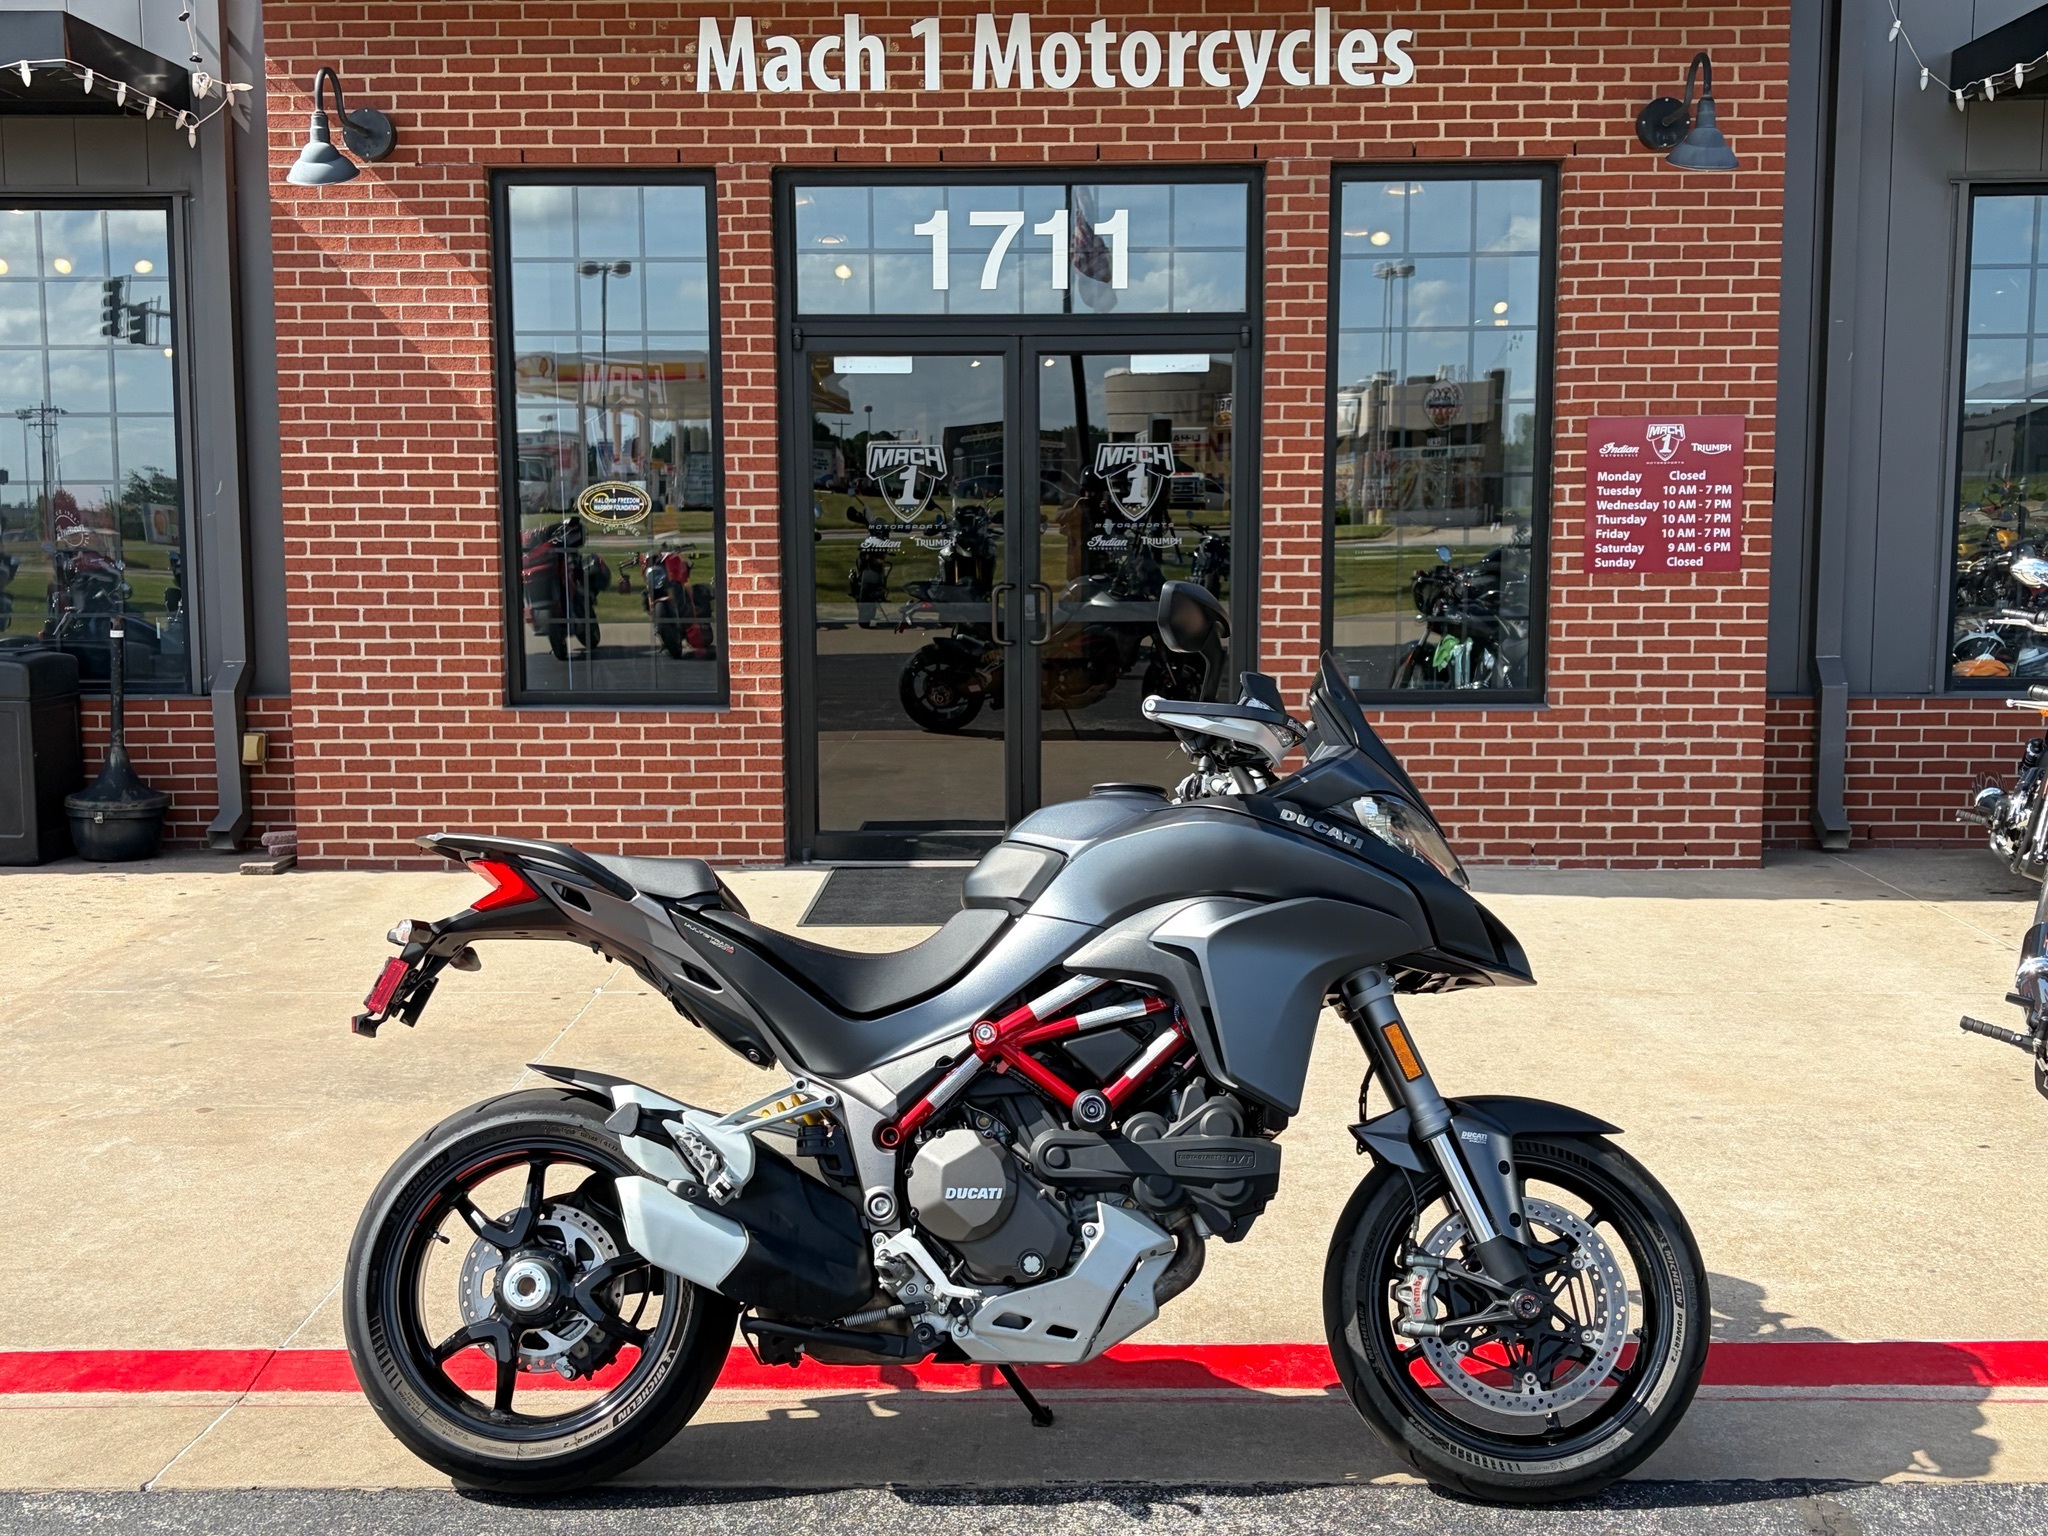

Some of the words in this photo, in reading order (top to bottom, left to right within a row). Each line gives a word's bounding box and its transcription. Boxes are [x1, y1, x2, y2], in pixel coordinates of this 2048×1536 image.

[696, 13, 887, 93] Mach
[910, 17, 941, 91] 1
[972, 7, 1415, 109] Motorcycles
[914, 209, 1129, 290] 1711
[1648, 426, 1684, 438] MACH
[1598, 442, 1640, 454] Indian
[1658, 433, 1672, 453] 1
[1690, 442, 1732, 453] TRIUMPH
[870, 448, 944, 474] MACH
[1098, 446, 1172, 472] MACH
[1597, 471, 1642, 483] Monday
[1669, 470, 1706, 480] Closed
[894, 465, 920, 505] 1
[1122, 463, 1147, 504] 1
[1596, 486, 1642, 498] Tuesday
[1662, 485, 1676, 495] 10
[1678, 485, 1696, 495] AM
[1706, 485, 1713, 494] 7
[1714, 485, 1732, 494] PM
[1596, 500, 1660, 512] Wednesday
[1662, 500, 1676, 510] 10
[1678, 500, 1696, 509] AM
[1705, 500, 1712, 509] 7
[1714, 499, 1732, 509] PM
[1596, 514, 1647, 526] Thursday
[1662, 514, 1676, 524] 10
[1677, 514, 1696, 524] AM
[1705, 514, 1712, 523] 7
[1714, 514, 1731, 523] PM
[1087, 535, 1129, 547] Indian
[1140, 536, 1182, 546] TRIUMPH
[1595, 529, 1630, 541] Friday
[1662, 529, 1675, 538] 10
[1677, 528, 1696, 538] AM
[1704, 528, 1711, 538] 7
[1713, 528, 1731, 537] PM
[860, 536, 902, 548] Indian
[914, 538, 956, 548] TRIUMPH
[1595, 543, 1644, 555] Saturday
[1668, 543, 1675, 552] 9
[1677, 543, 1696, 552] AM
[1704, 542, 1711, 552] 6
[1713, 542, 1731, 552] PM
[1594, 558, 1636, 569] Sunday
[1666, 556, 1704, 567] Closed
[1279, 808, 1364, 850] DUCATI
[1461, 1130, 1488, 1140] DUCATI
[1226, 1154, 1253, 1164] DVT
[399, 1156, 446, 1208] MICHELIN
[944, 1187, 1003, 1200] DUCATI
[1413, 1274, 1424, 1316] brembo
[1664, 1250, 1684, 1306] MICHELIN
[1674, 1312, 1684, 1351] POWER
[1358, 1306, 1376, 1360] MICHELIN
[618, 1364, 666, 1422] MICHELIN
[577, 1424, 609, 1444] POWER
